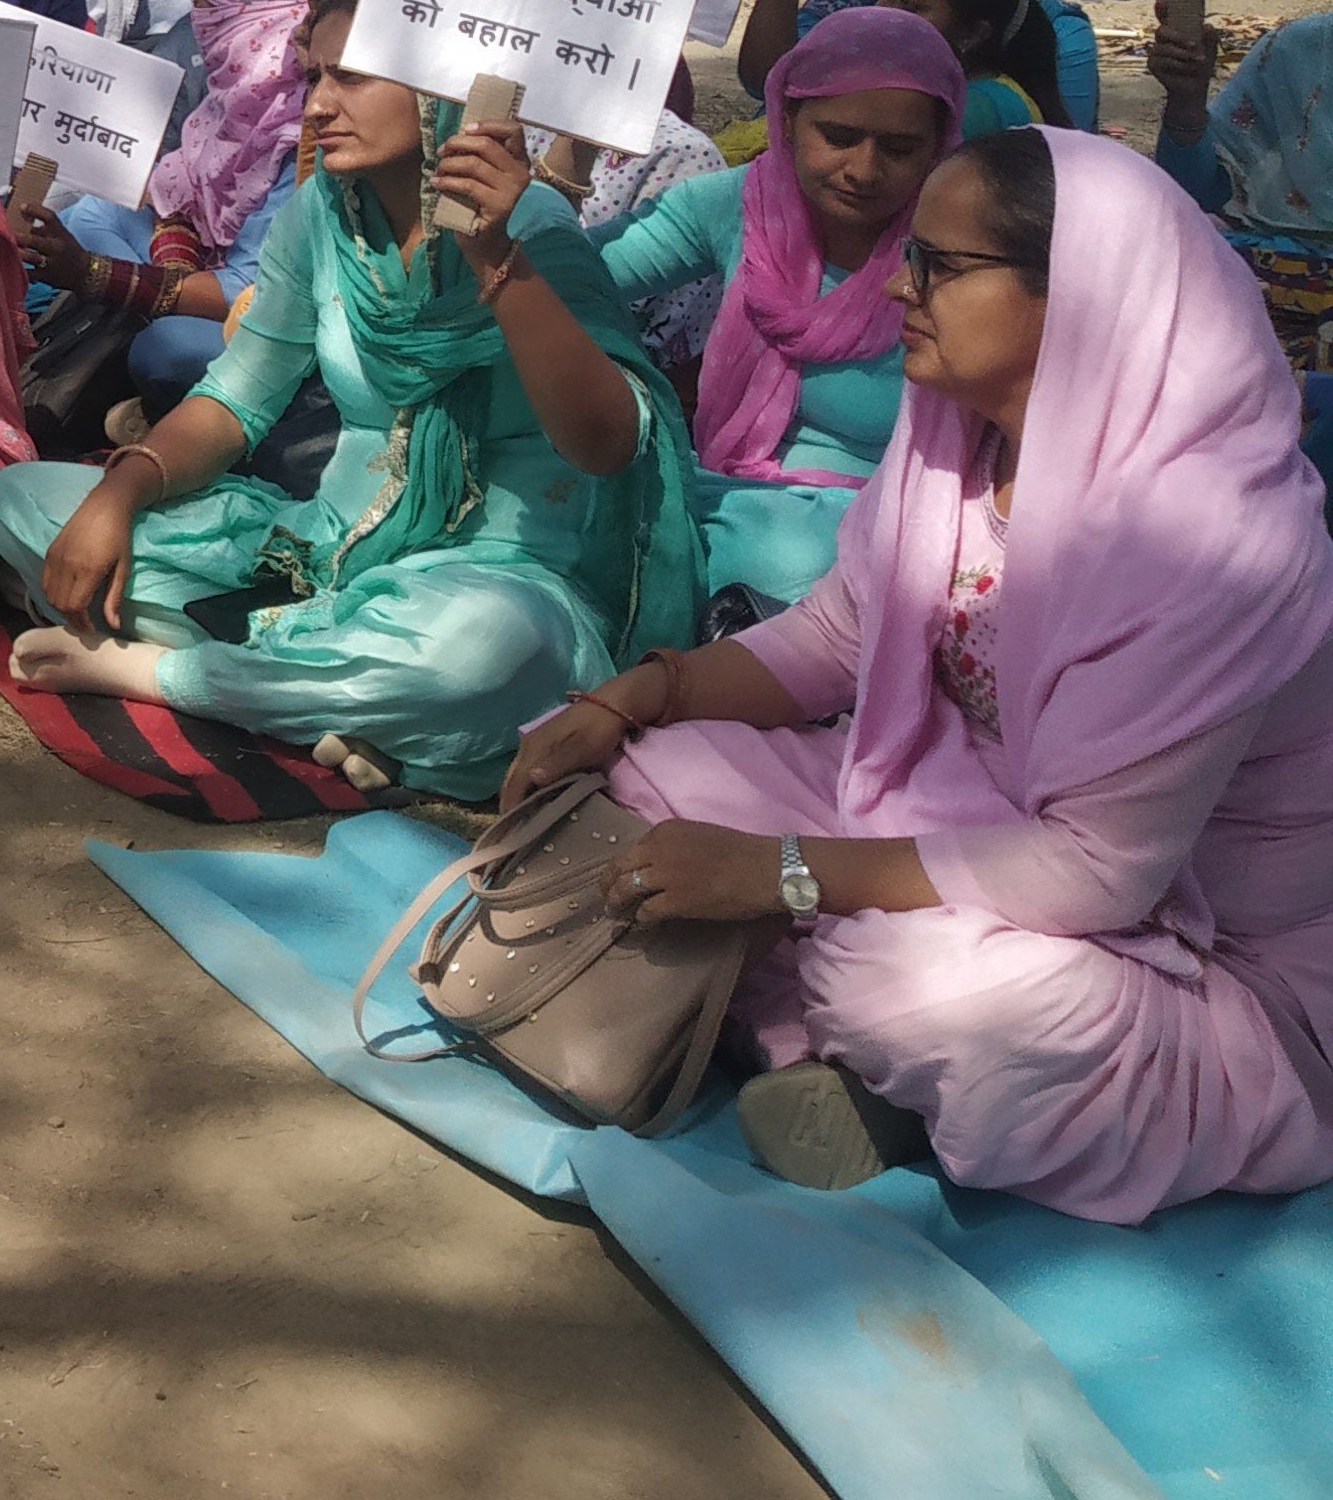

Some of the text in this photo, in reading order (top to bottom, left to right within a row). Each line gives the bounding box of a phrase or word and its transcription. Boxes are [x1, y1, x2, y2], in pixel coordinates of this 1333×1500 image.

[458, 12, 541, 54] बहाल
[555, 38, 616, 76] करो
[54, 115, 139, 159] मुर्दाबाद
